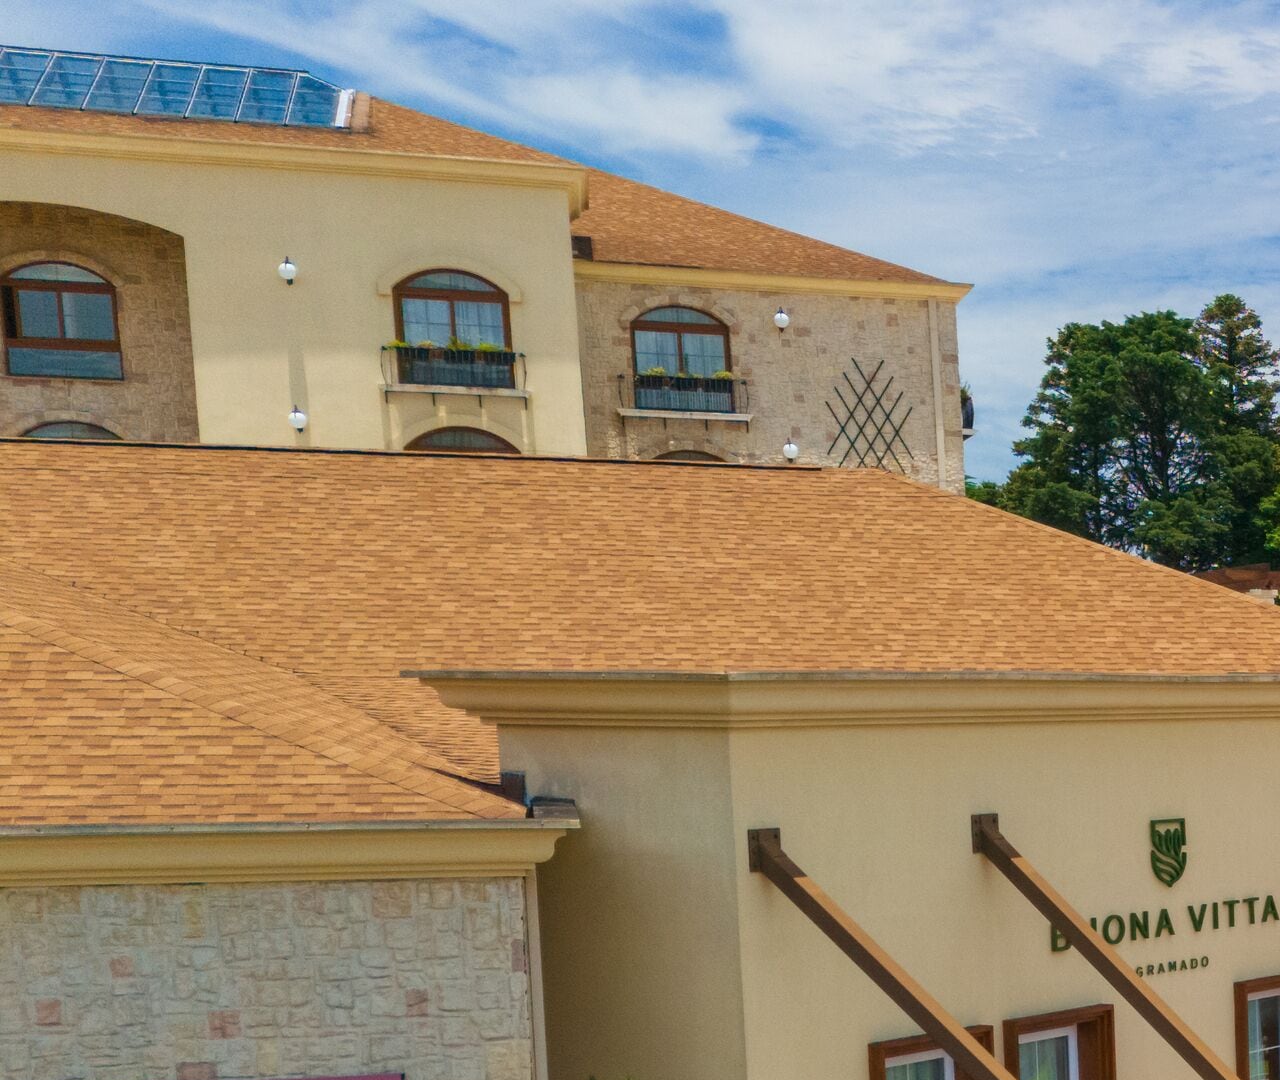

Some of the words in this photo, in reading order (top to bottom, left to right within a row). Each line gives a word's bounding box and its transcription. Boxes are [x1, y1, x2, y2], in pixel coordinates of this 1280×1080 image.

[1050, 908, 1176, 952] BONA
[1187, 894, 1280, 933] VITTA
[1135, 956, 1209, 977] GRAMADO
